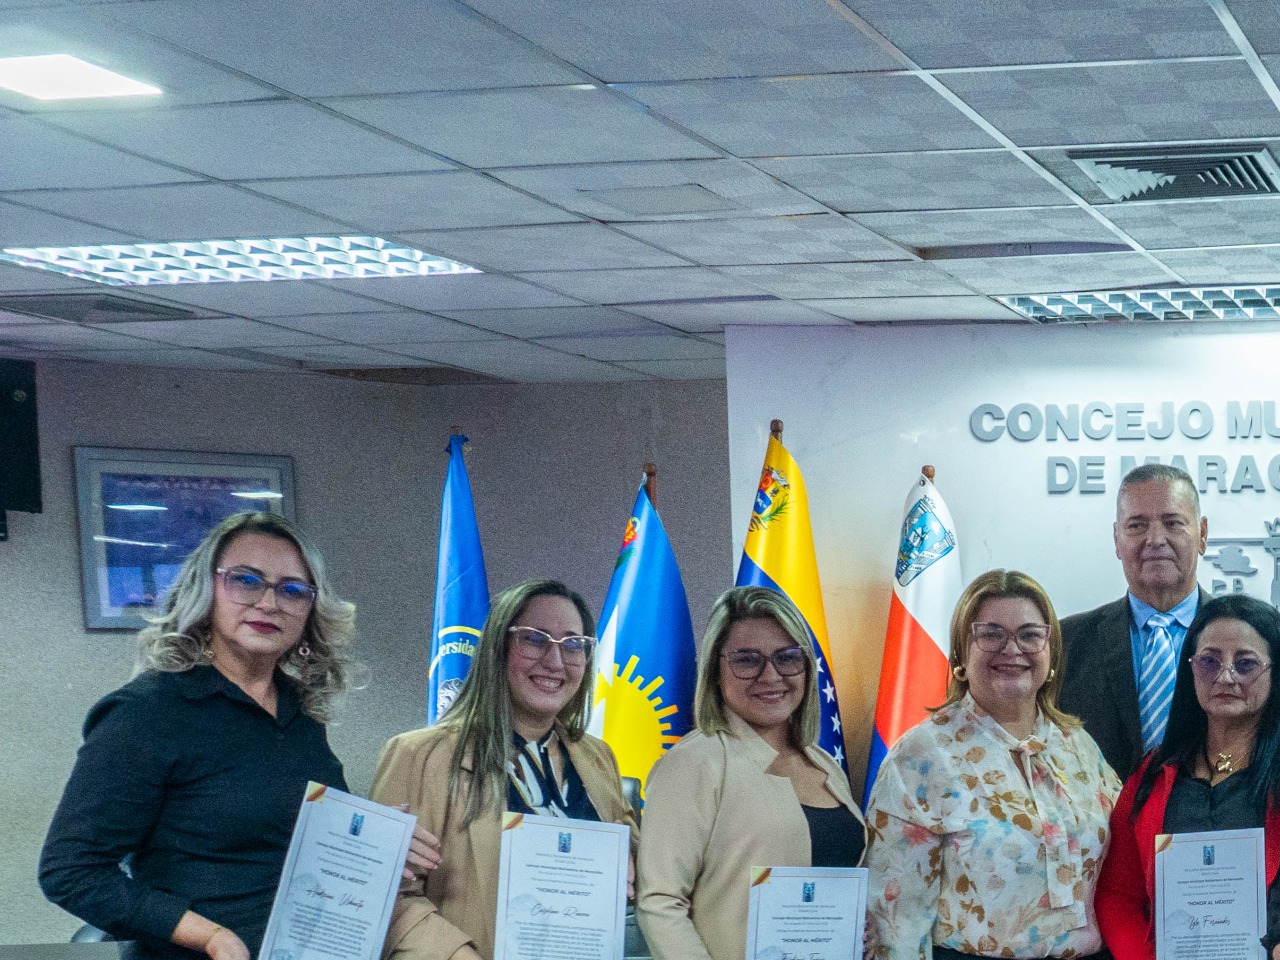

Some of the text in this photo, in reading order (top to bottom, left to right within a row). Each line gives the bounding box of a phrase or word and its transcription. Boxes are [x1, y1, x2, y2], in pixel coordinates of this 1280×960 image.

[969, 401, 1214, 442] CONCEJO
[1047, 456, 1106, 494] DE
[439, 638, 476, 657] ersida
